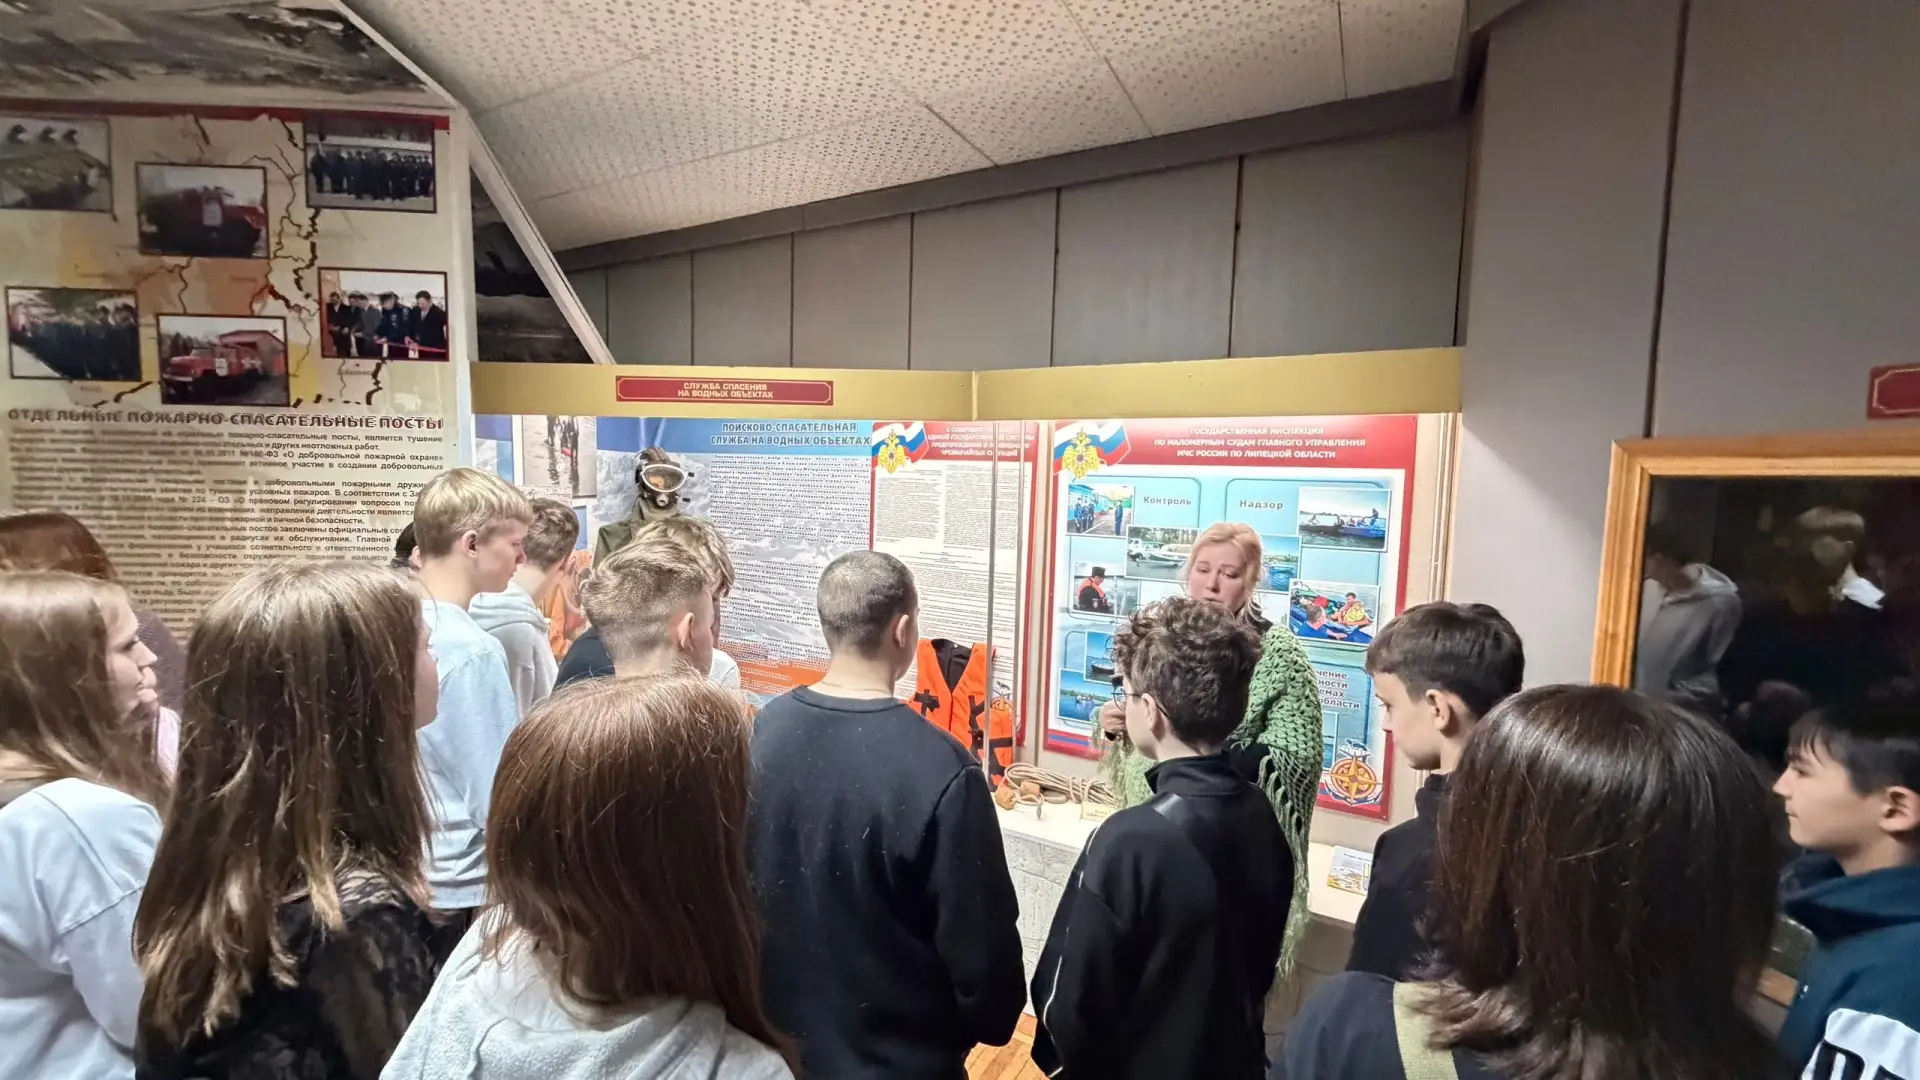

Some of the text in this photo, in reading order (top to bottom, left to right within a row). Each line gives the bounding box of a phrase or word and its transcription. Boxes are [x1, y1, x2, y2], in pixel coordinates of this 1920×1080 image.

[722, 383, 768, 391] СПАСЕНИЯ
[692, 390, 728, 398] ВОДНЫХ
[8, 410, 443, 430] ОТДЕЛЬНЫЕ ПОЖАРНО-СПАСАТЕЛЬНЫЕ ПОСТЫ
[722, 422, 857, 432] ПОИСКОВО-СПАСАТЕЛЬНАЯ
[1190, 427, 1324, 436] ГОСУДАРСТВЕННАЯ ИНСПЕКЦИЯ
[228, 431, 328, 440] пожарно-спасательные
[332, 434, 360, 442] посты,
[407, 436, 443, 444] тушение
[710, 436, 872, 446] СЛУЖБА НА ВОДНЫХ ОБЪЕКТАХ
[1304, 438, 1366, 446] УПРАВЛЕНИЯ
[354, 443, 380, 452] работ.
[298, 451, 360, 460] добровольной
[364, 453, 406, 462] пожарной
[1244, 450, 1292, 458] ЛИПЕЦКОЙ
[292, 462, 324, 470] участие
[380, 463, 444, 471] добровольных
[264, 479, 336, 487] добровольными
[248, 488, 290, 497] условных
[293, 490, 332, 498] пожаров.
[1143, 496, 1192, 506] Контроль
[1240, 500, 1284, 510] Надзор
[316, 508, 376, 516] деятельности
[328, 526, 388, 534] официальные
[288, 535, 352, 543] обслуживания.
[1316, 670, 1348, 680] чение
[1318, 680, 1348, 688] ности
[1320, 689, 1344, 698] емах
